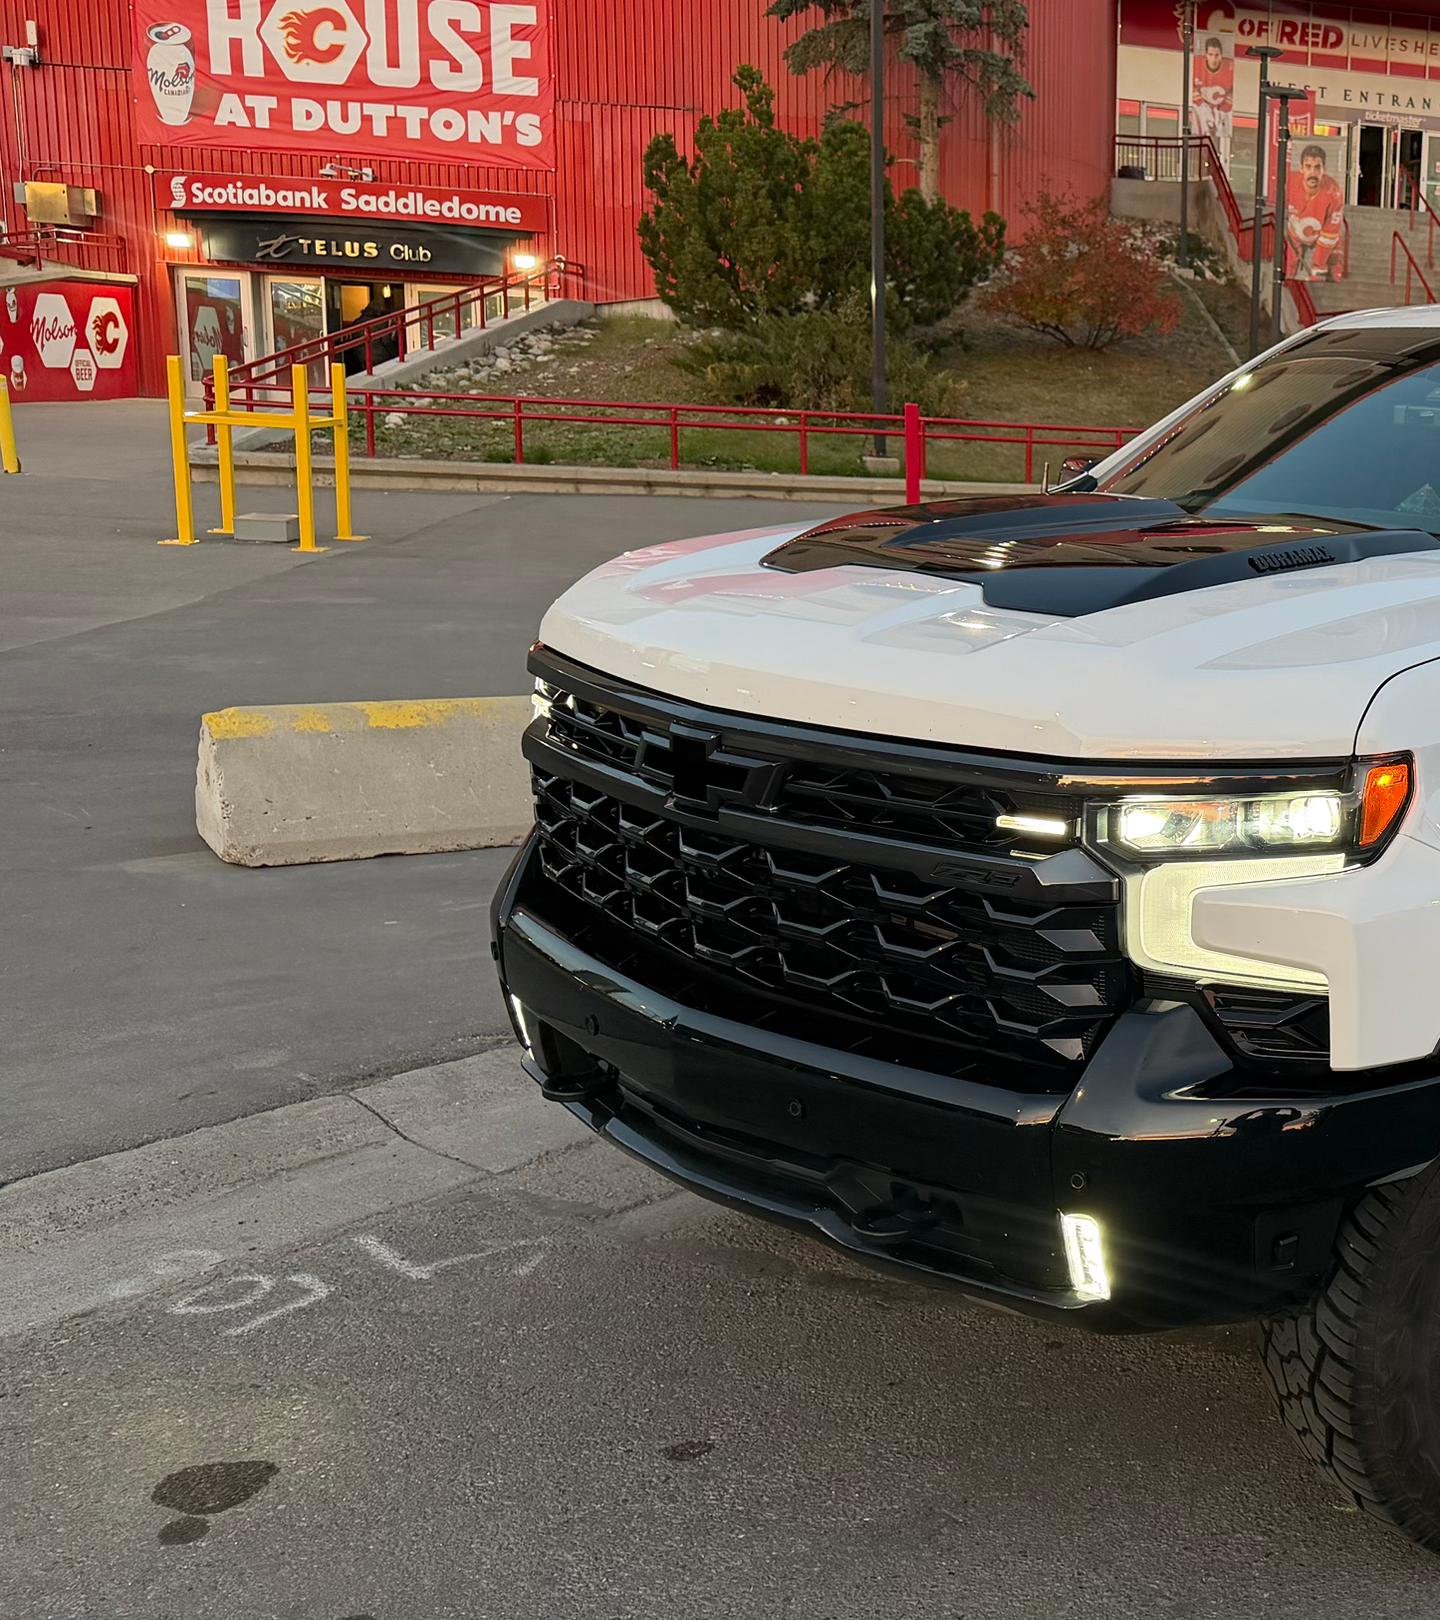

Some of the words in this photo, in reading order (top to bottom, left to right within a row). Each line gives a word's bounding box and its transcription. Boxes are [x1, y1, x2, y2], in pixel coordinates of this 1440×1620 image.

[1279, 18, 1344, 49] RED
[213, 92, 278, 129] AT
[291, 97, 543, 146] DUTTON'S
[1365, 111, 1421, 126] ticketmaster
[190, 181, 329, 209] Scotiabank
[340, 187, 522, 224] Saddledome
[298, 237, 378, 258] TELUS
[390, 243, 432, 262] Club
[75, 367, 93, 381] BEER
